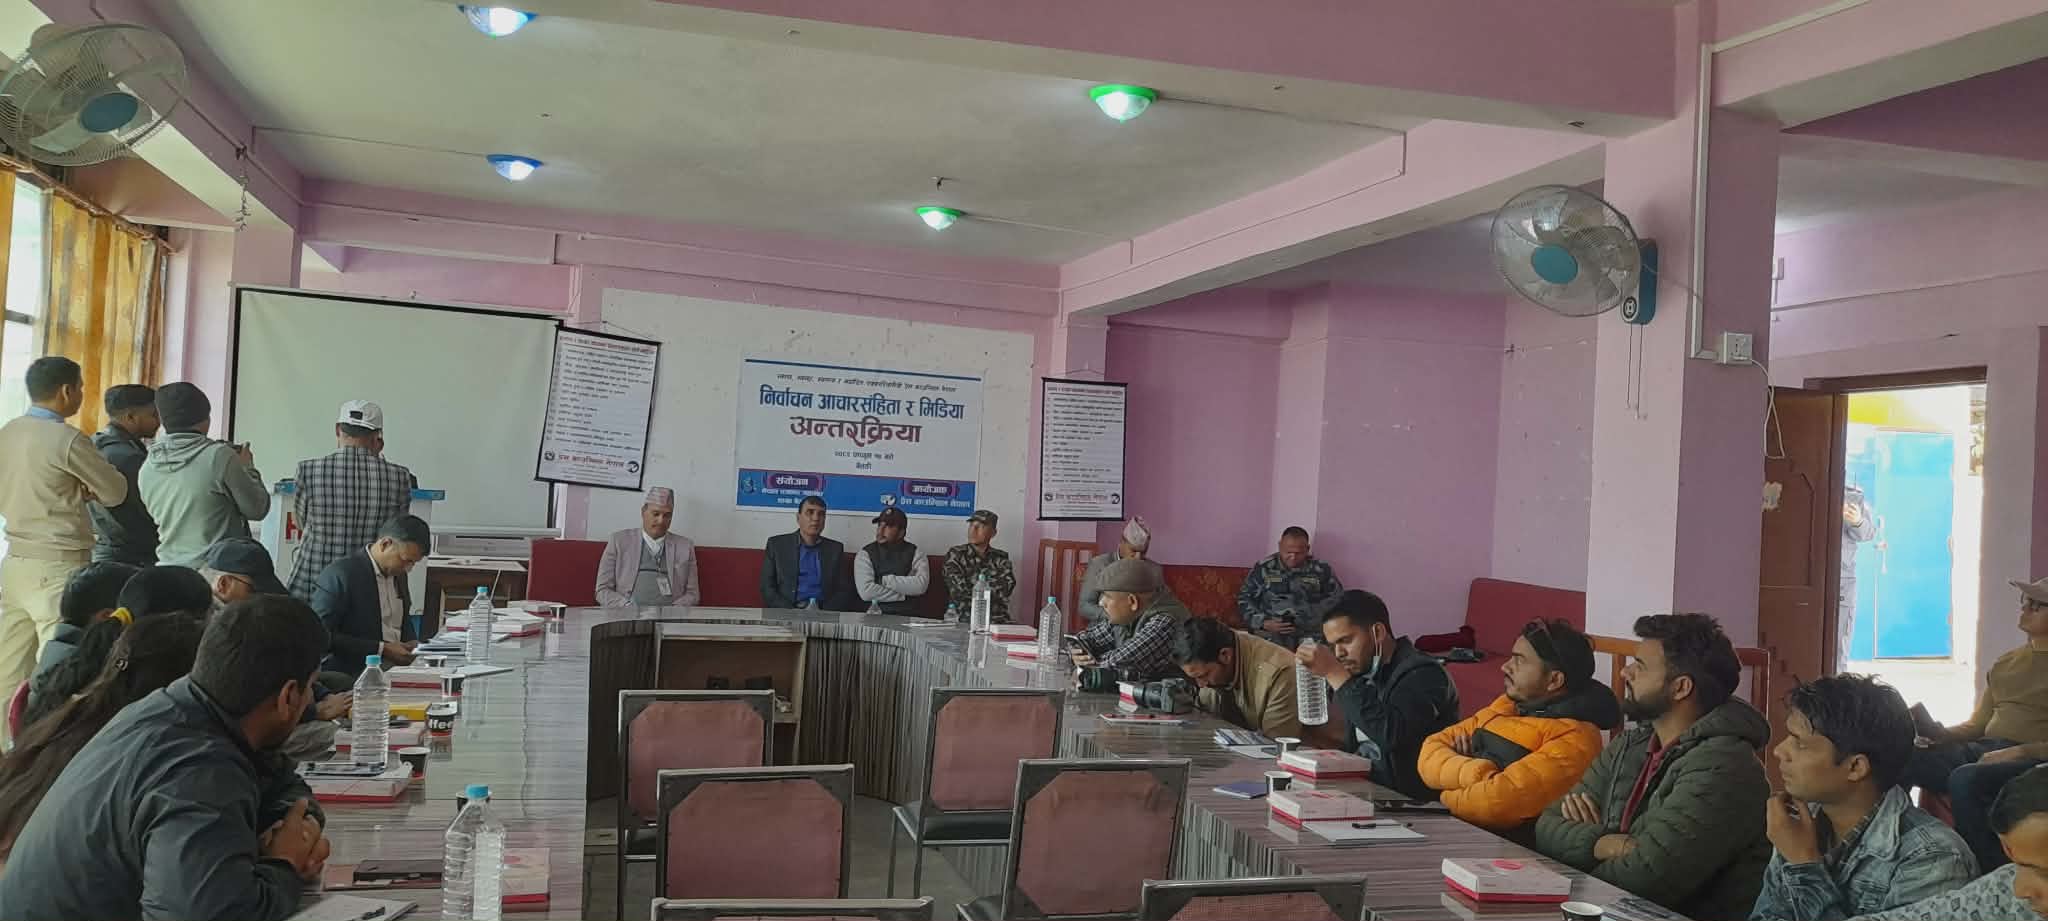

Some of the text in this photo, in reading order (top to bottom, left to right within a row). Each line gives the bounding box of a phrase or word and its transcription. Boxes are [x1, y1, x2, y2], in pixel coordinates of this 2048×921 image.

[760, 384, 964, 420] निर्वाचन आचारसंहिता र मिडिया
[789, 415, 922, 447] अन्तरक्रिया
